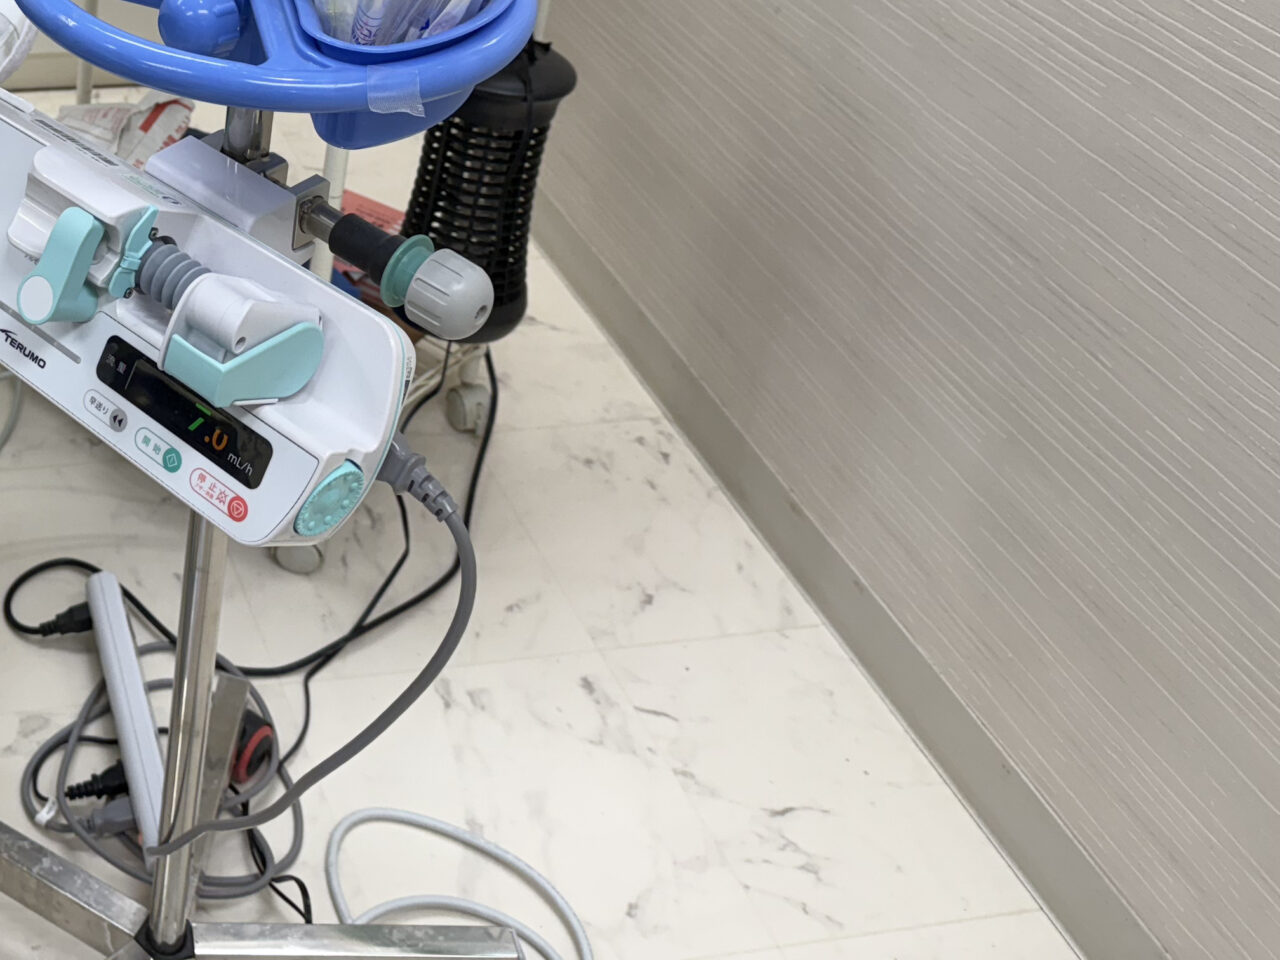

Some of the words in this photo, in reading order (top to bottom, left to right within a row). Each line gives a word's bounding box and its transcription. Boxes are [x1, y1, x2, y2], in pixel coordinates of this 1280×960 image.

[0, 330, 47, 369] TERUMO
[88, 395, 110, 416] 早送り
[141, 434, 162, 456] 開始
[227, 452, 253, 477] mL/h
[196, 472, 218, 492] 停止
